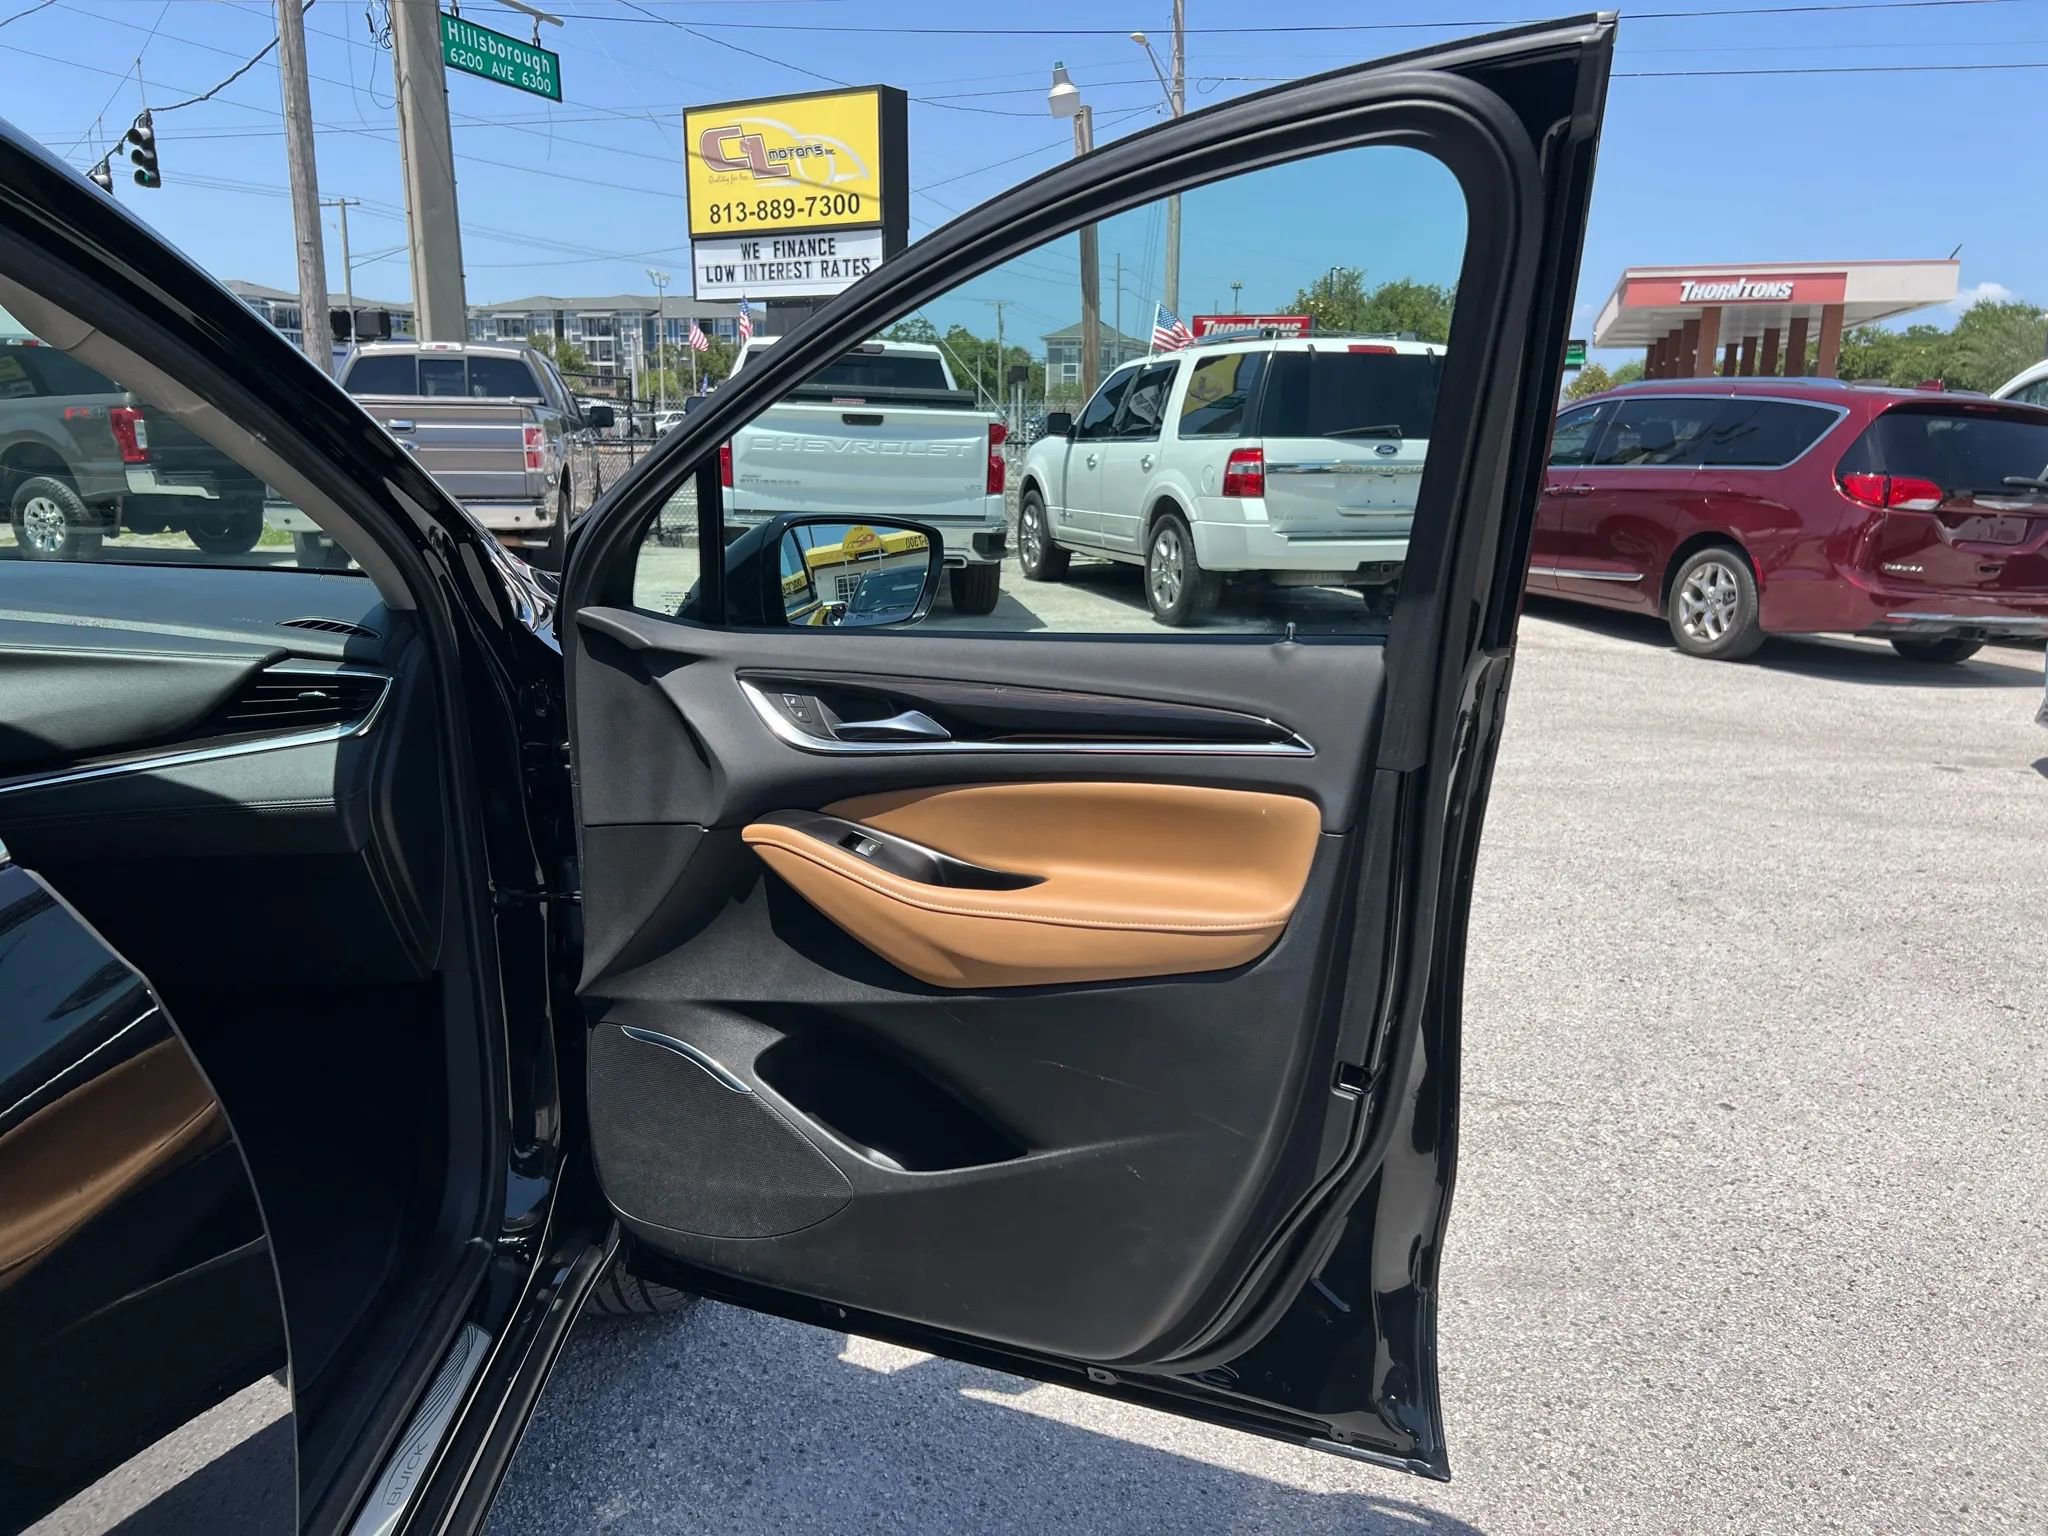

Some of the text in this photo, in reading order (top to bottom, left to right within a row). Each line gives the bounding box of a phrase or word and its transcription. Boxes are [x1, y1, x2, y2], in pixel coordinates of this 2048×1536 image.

[447, 20, 550, 75] Hillsborough
[450, 47, 551, 93] 6200 AVE 6300
[709, 192, 860, 224] 813-889-7300
[740, 237, 836, 261] WE FINANCE
[706, 257, 870, 283] LOW INTEREST RATES
[1680, 277, 1794, 302] THORNTONS
[751, 436, 974, 457] CHEVROLET
[386, 1443, 428, 1507] BUICK
